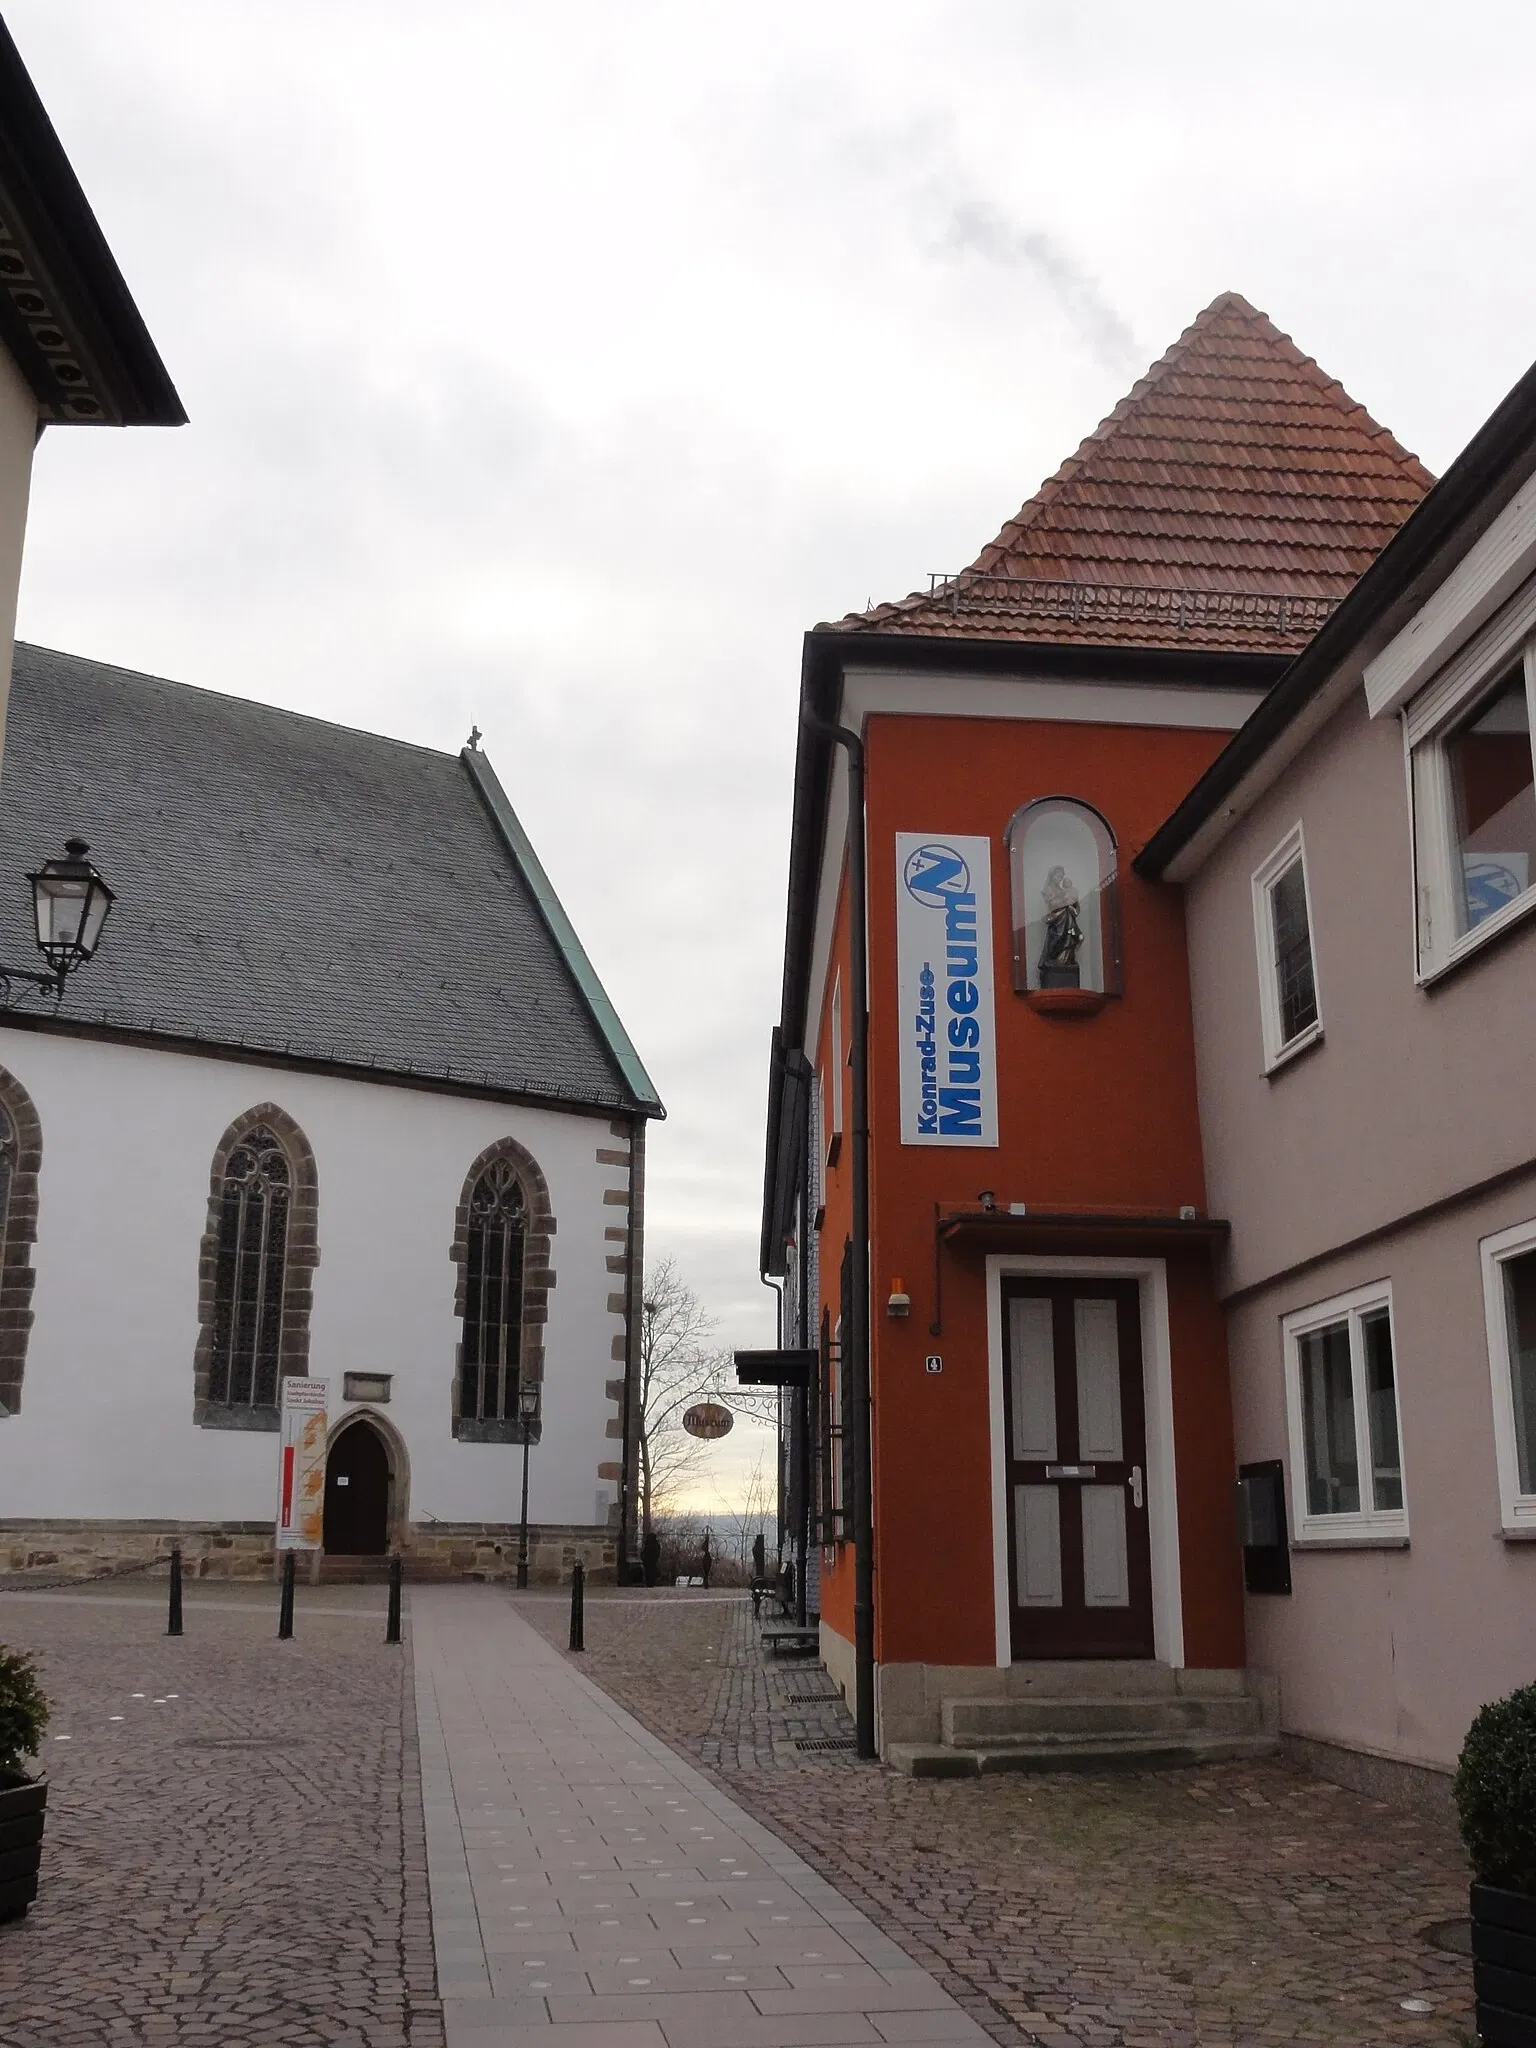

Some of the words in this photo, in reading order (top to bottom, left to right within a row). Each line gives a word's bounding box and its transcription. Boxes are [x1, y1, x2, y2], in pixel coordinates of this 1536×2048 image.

[916, 962, 938, 1135] Konrad-Zuse-
[938, 892, 982, 1136] Museum
[287, 1380, 326, 1391] Sanierung
[930, 1358, 938, 1370] 4
